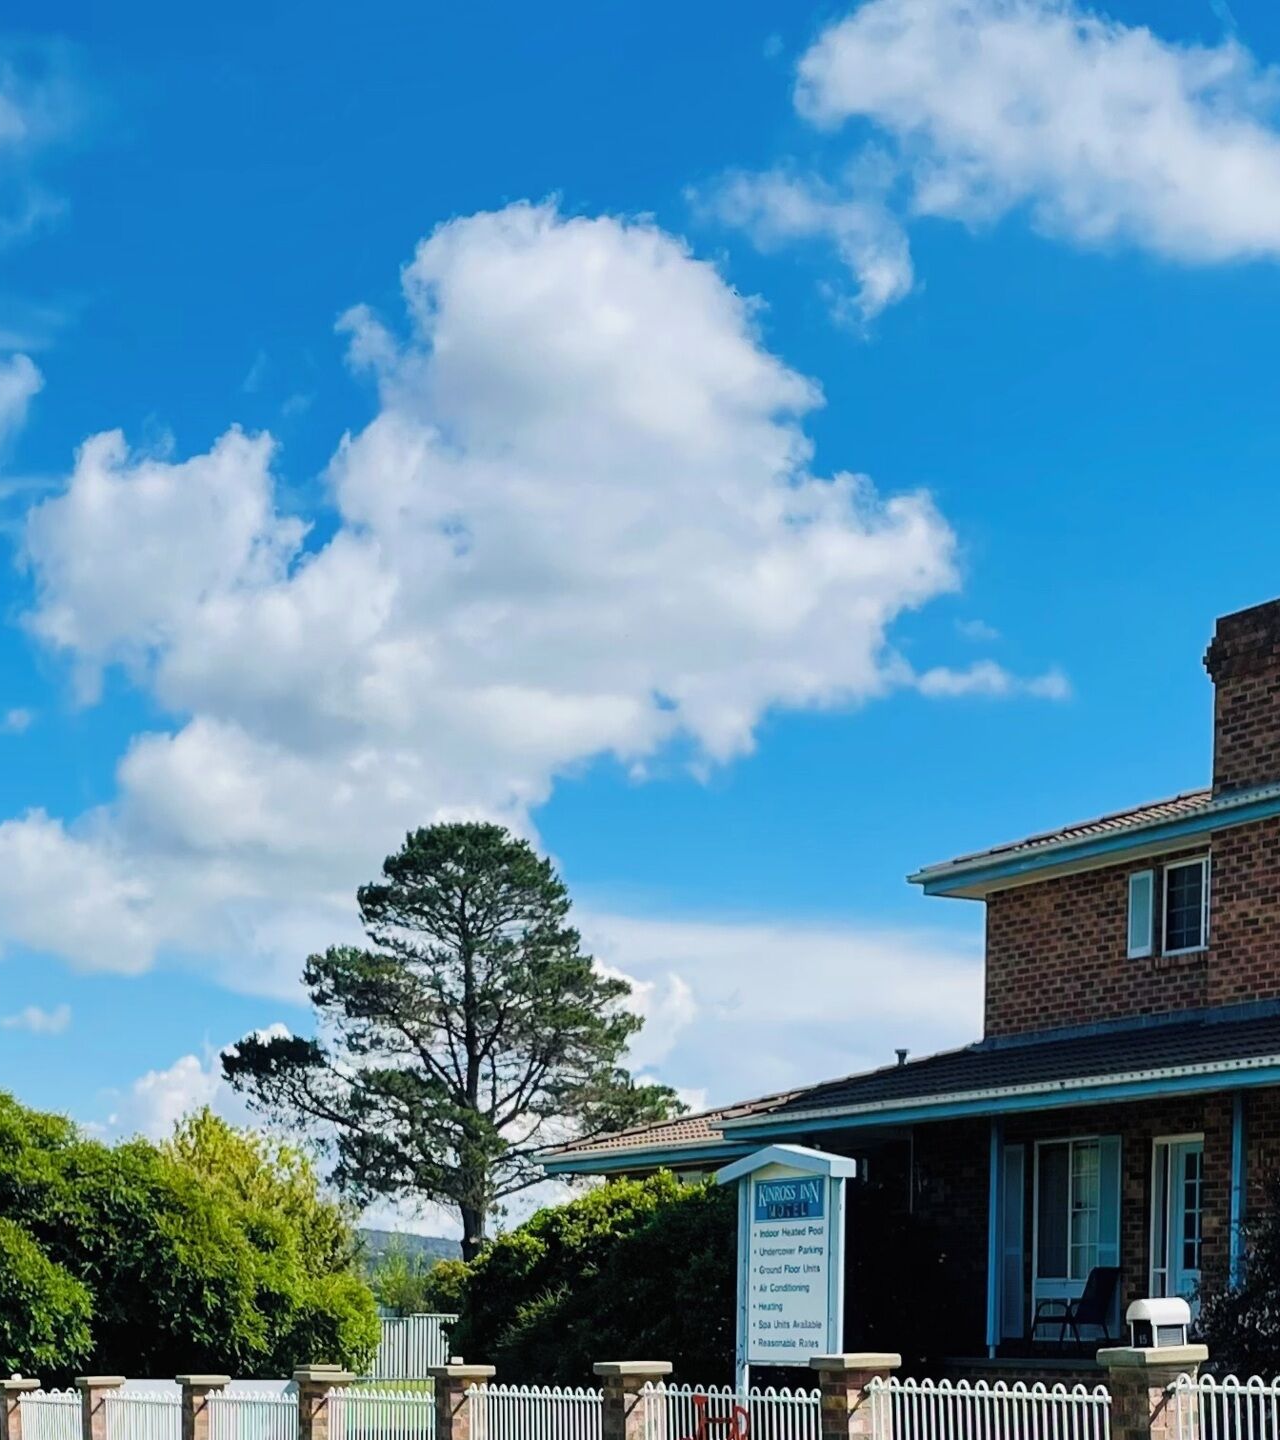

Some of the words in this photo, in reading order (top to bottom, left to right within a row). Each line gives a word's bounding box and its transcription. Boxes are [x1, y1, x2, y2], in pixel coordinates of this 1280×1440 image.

[758, 1184, 797, 1207] KINROSS
[800, 1180, 820, 1203] INN
[768, 1202, 808, 1218] MOTEL
[760, 1229, 780, 1238] Indoor
[781, 1227, 806, 1237] Heated
[808, 1226, 824, 1236] Pool
[759, 1247, 796, 1257] Undercover
[798, 1245, 824, 1256] Parking
[759, 1265, 782, 1275] Ground
[784, 1264, 801, 1274] Floor
[803, 1264, 821, 1273] Units
[759, 1284, 767, 1293] Air
[769, 1283, 810, 1293] Conditioning
[758, 1303, 783, 1312] Heating
[758, 1320, 771, 1329] Spa
[773, 1319, 790, 1329] Units
[792, 1320, 822, 1329] Available
[758, 1338, 796, 1348] Reasonable
[798, 1338, 819, 1348] Rates
